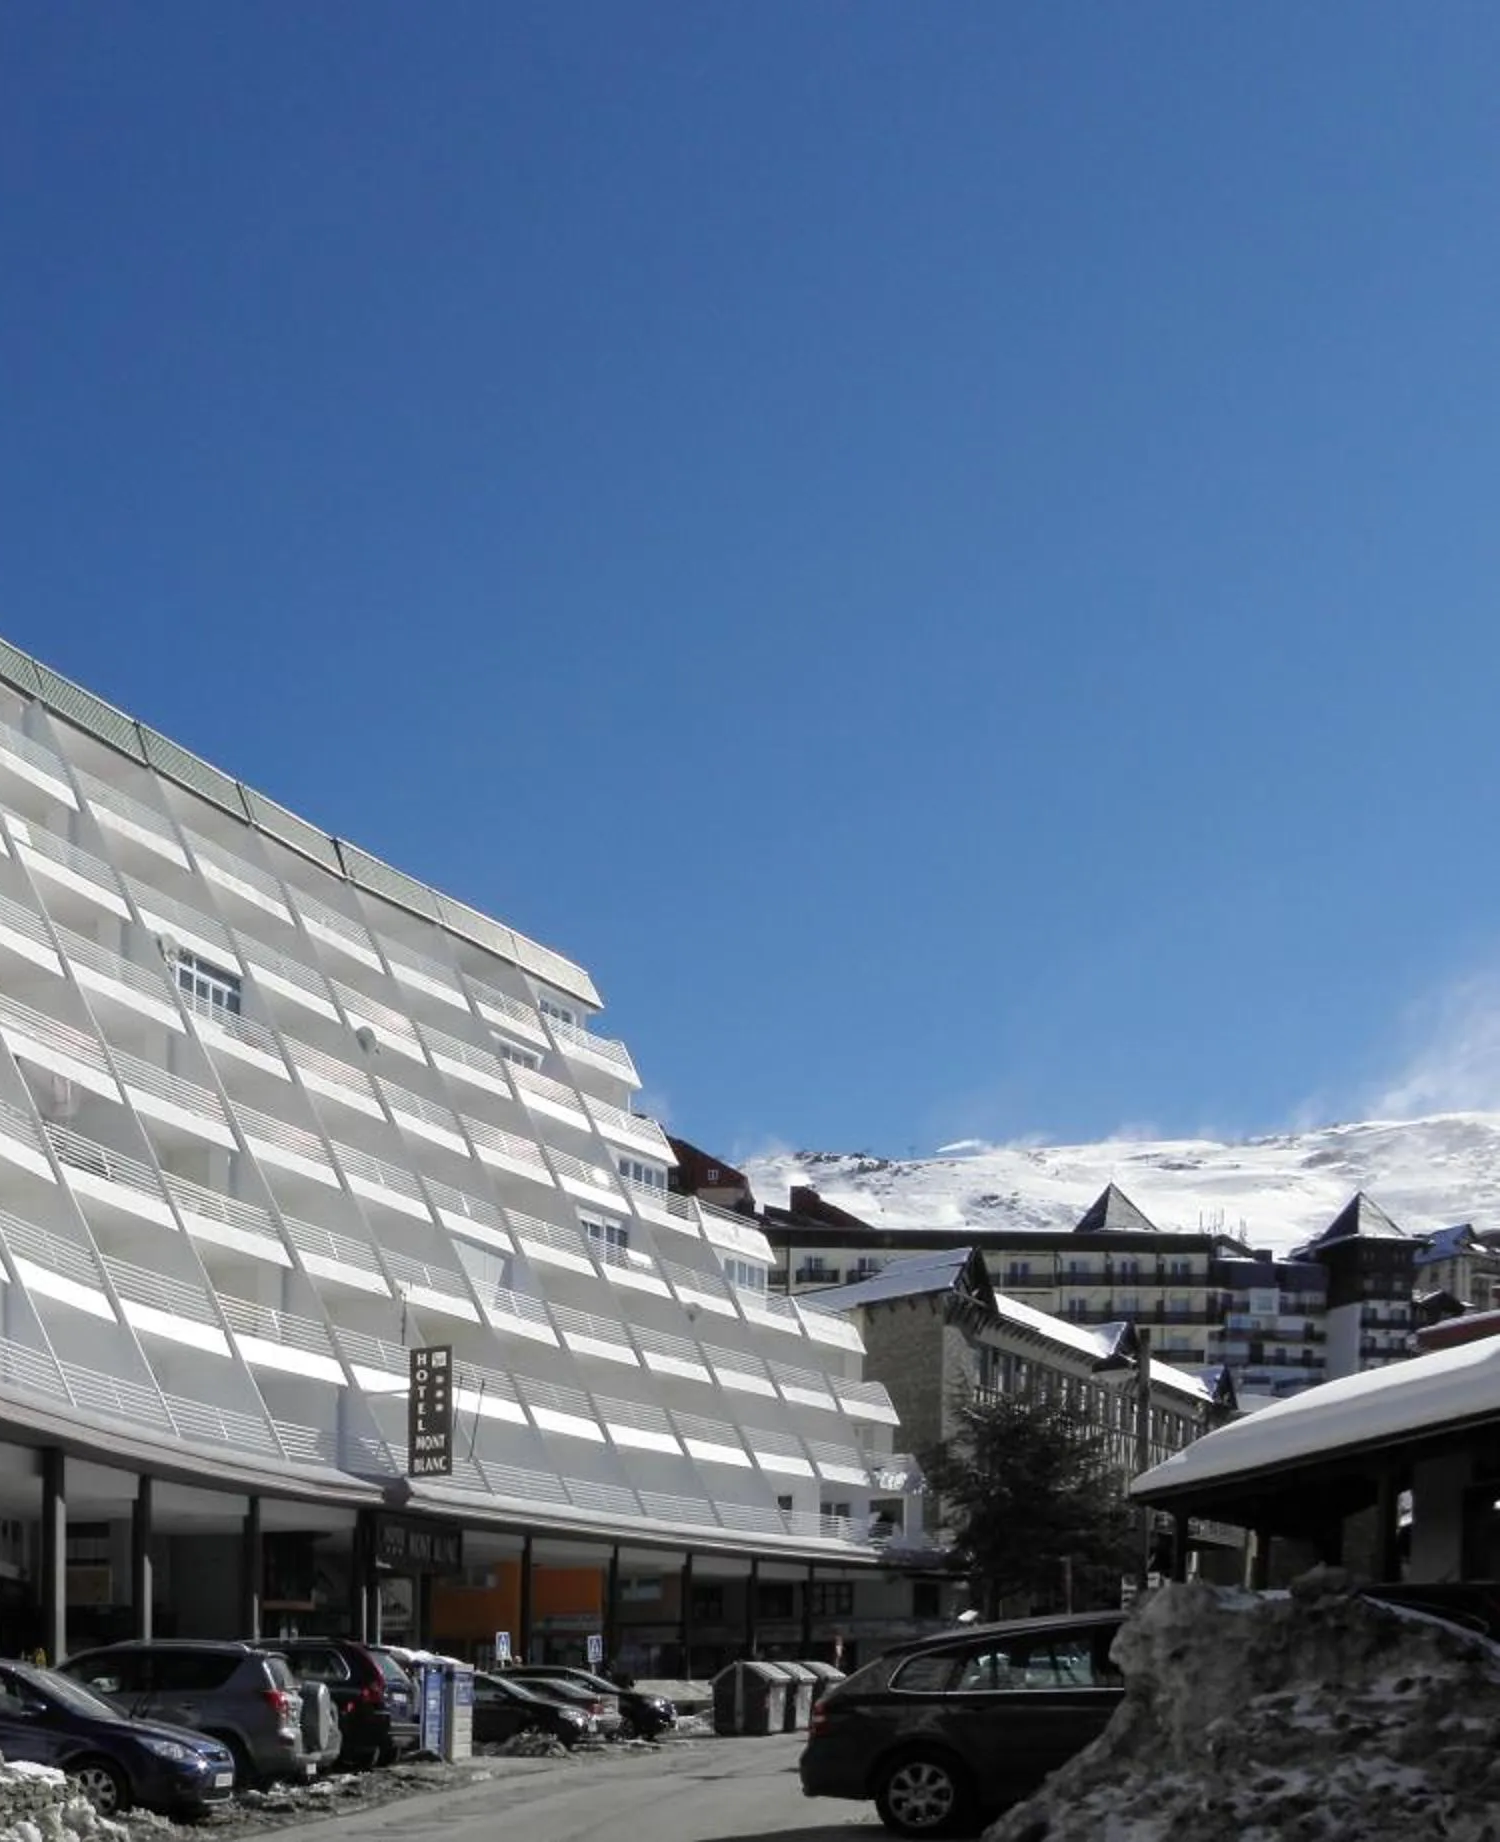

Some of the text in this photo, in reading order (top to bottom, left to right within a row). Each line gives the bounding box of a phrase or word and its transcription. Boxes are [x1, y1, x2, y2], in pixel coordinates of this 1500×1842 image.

[415, 1353, 429, 1433] HOTEL
[415, 1433, 446, 1451] MONT
[413, 1456, 448, 1473] BLANC
